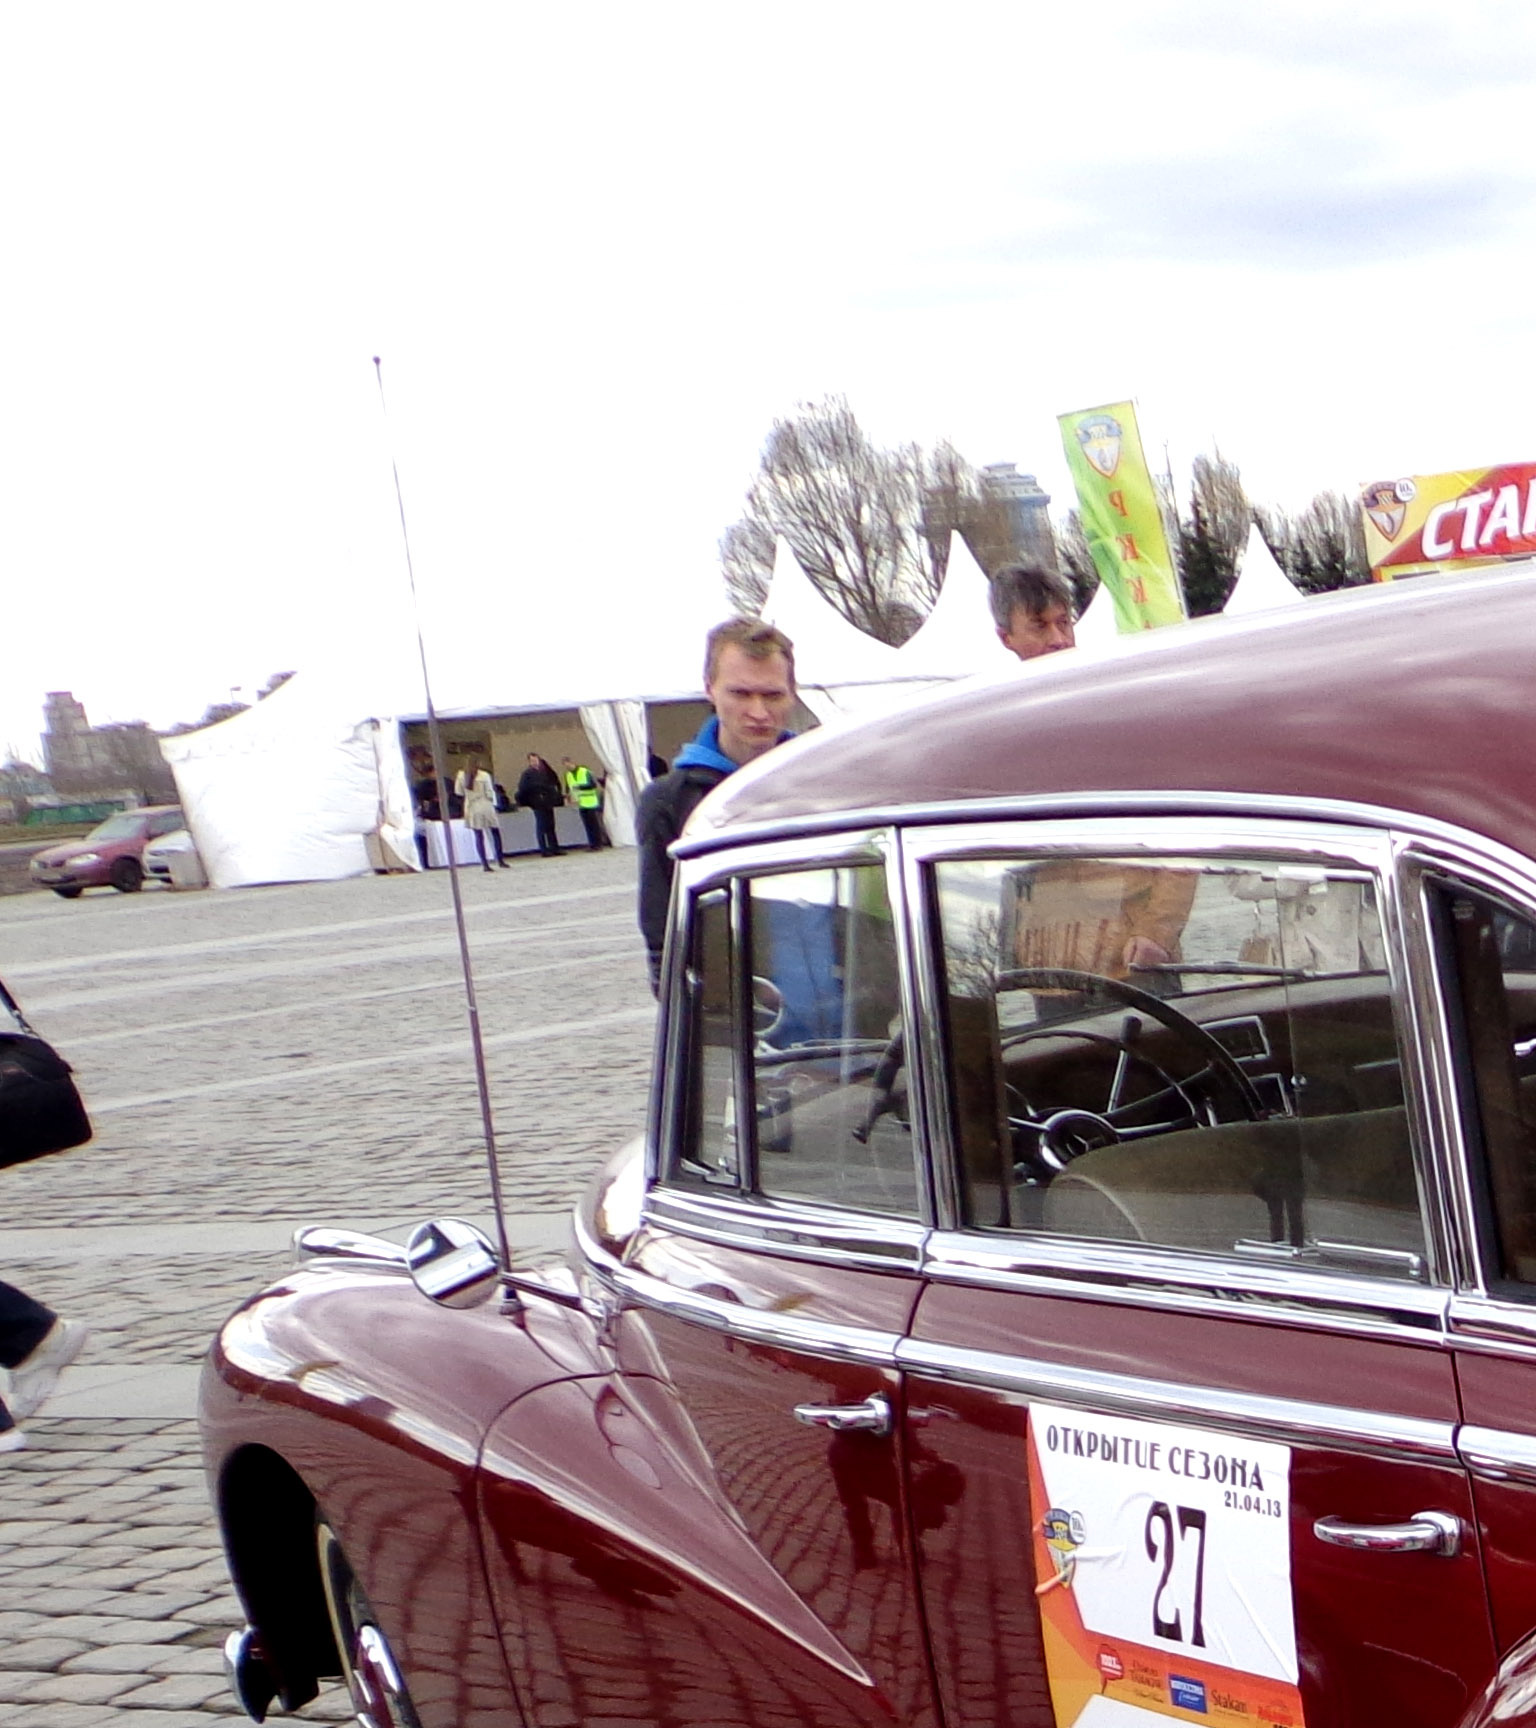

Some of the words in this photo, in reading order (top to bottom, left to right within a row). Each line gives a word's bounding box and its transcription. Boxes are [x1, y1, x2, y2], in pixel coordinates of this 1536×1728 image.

[1168, 1446, 1264, 1491] СЕЗОНА
[1224, 1490, 1282, 1518] 21.04.13
[1145, 1500, 1207, 1648] 27
